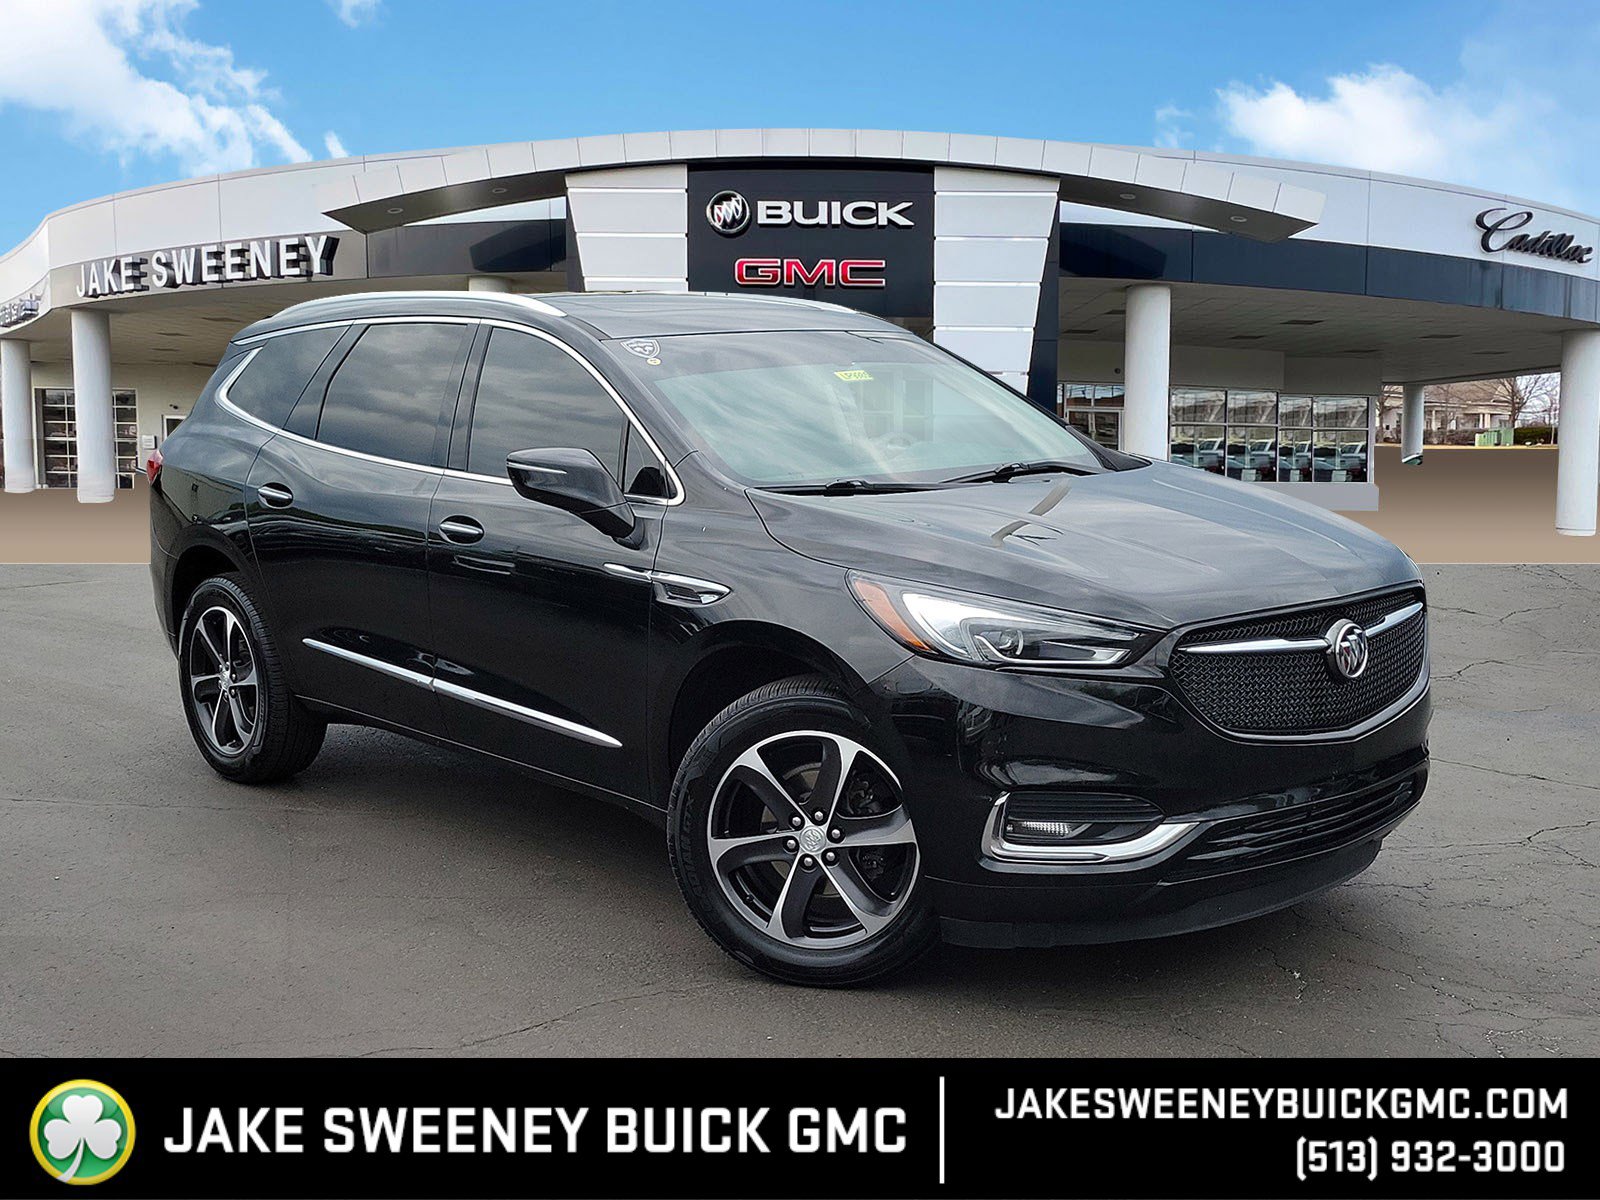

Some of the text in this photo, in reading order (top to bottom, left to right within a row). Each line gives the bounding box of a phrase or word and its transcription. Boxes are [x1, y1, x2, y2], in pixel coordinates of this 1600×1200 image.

[757, 201, 914, 227] BUICK
[1475, 207, 1593, 263] Cadillac
[76, 235, 338, 298] JAKE SWEENEY
[734, 257, 886, 287] GMC
